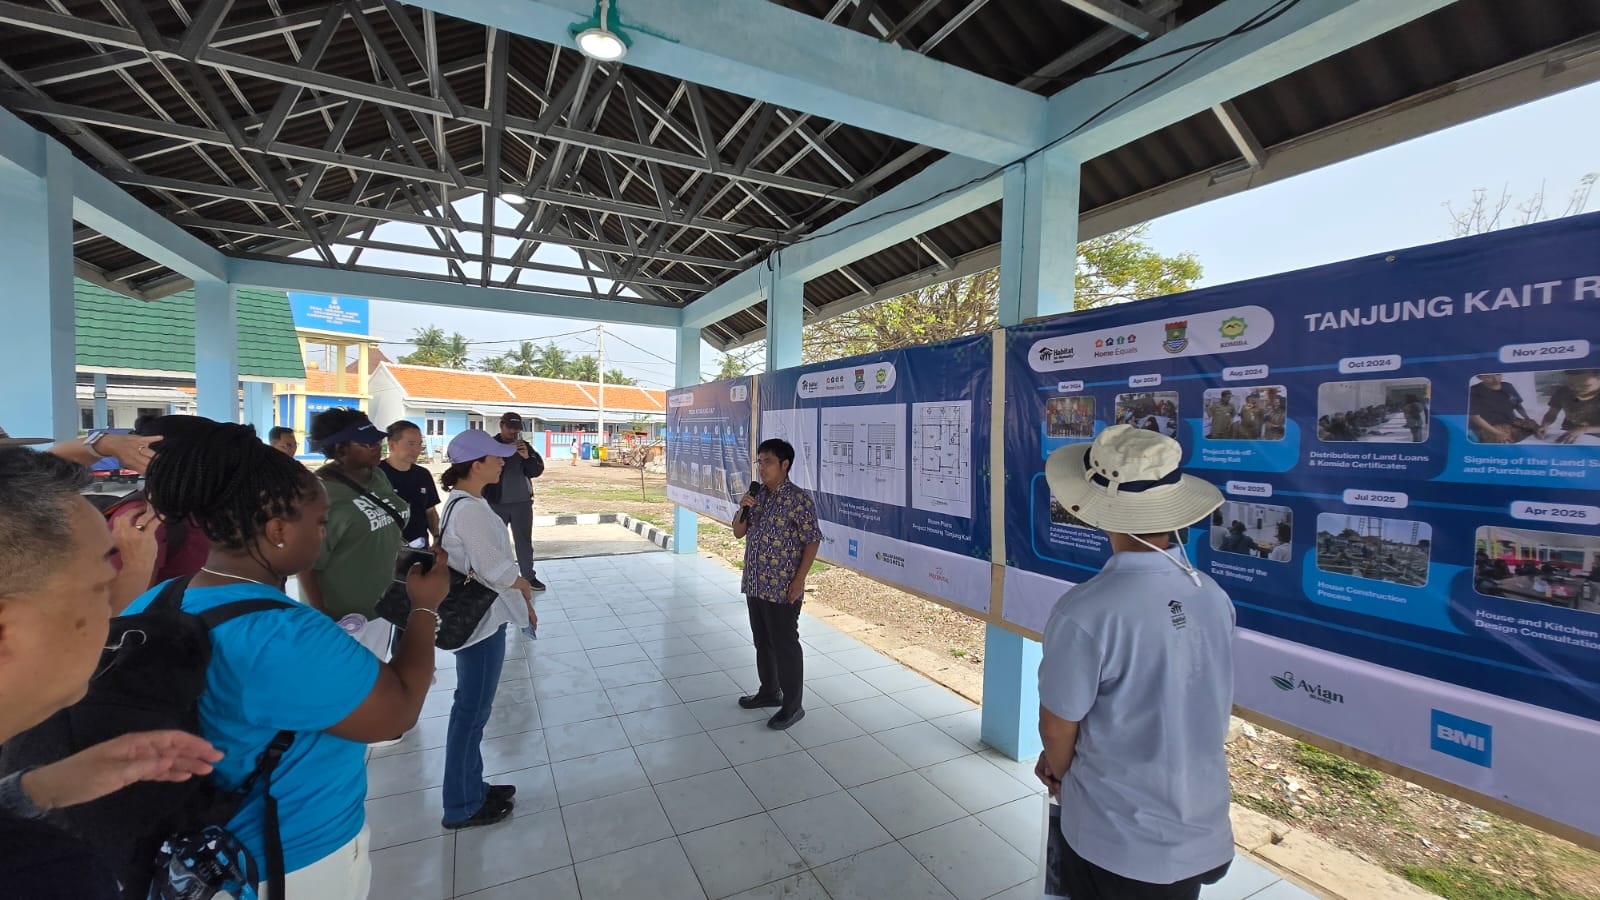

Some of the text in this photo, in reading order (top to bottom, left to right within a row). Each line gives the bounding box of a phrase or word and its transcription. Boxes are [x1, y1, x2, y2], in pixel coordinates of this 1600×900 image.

[1304, 296, 1452, 332] TANJUNG
[1464, 280, 1562, 313] KAIT
[1053, 347, 1074, 357] Habitat
[1094, 346, 1138, 358] Home Equals
[1512, 345, 1575, 357] Nov 2024
[1347, 358, 1391, 369] Oct 2024
[1229, 368, 1263, 378] Aug 2024
[1310, 451, 1429, 462] Distribution of Land Loans
[1464, 455, 1600, 467] Signing of the Land S
[1317, 460, 1350, 468] Komida
[1351, 461, 1407, 470] Certificates
[1487, 466, 1546, 477] Purchase
[1549, 468, 1585, 478] Deed
[1247, 485, 1266, 493] 2025
[1354, 493, 1396, 503] Jul 2025
[1525, 506, 1587, 518] Apr 2025
[1211, 560, 1248, 573] Discussion
[1256, 568, 1268, 577] the
[1211, 568, 1254, 582] Exit Strategy
[1317, 589, 1352, 602] Process
[1318, 581, 1407, 604] House Construction
[1475, 619, 1518, 634] Design
[1476, 609, 1598, 638] House and Kitchen
[1297, 679, 1344, 704] Avian
[1437, 724, 1485, 752] BMI
